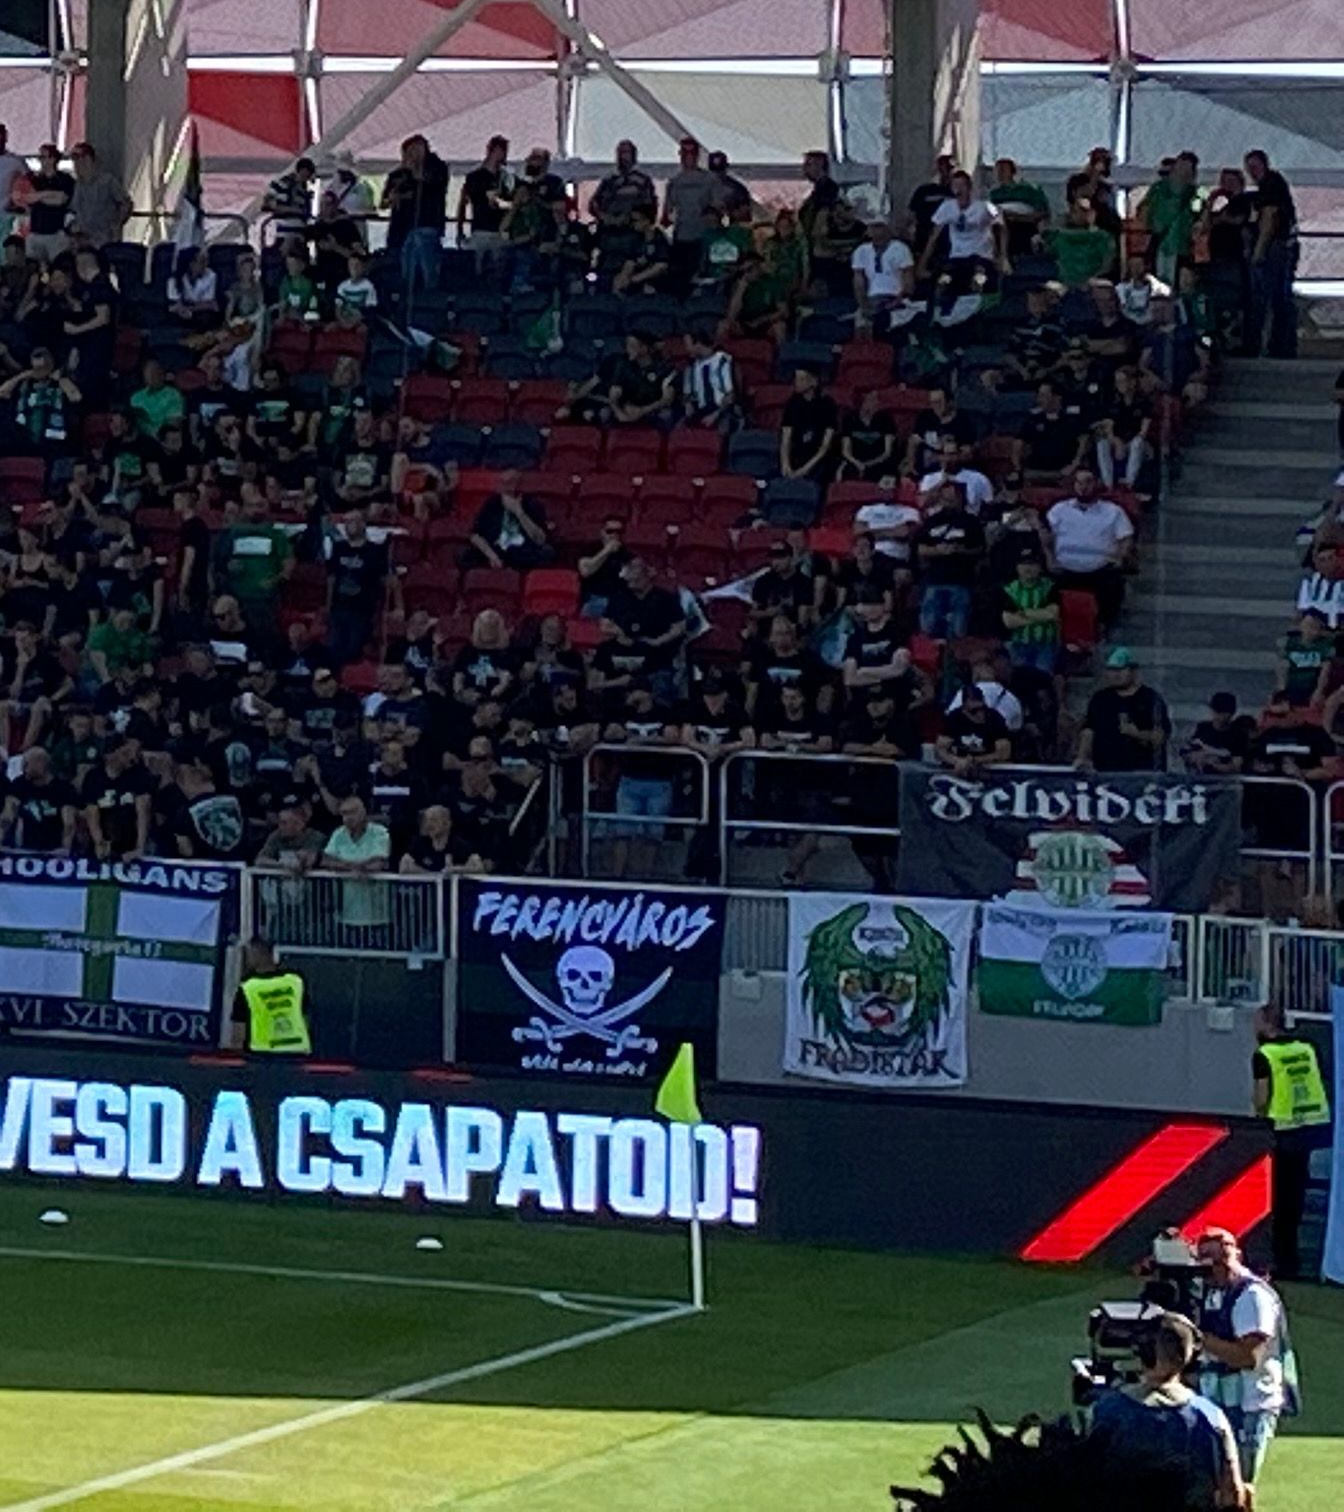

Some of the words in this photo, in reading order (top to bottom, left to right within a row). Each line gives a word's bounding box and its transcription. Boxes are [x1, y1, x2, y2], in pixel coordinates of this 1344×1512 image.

[62, 1002, 211, 1041] SZEKTOR
[199, 1092, 264, 1188] A
[277, 1097, 761, 1225] CSAPATOD!
